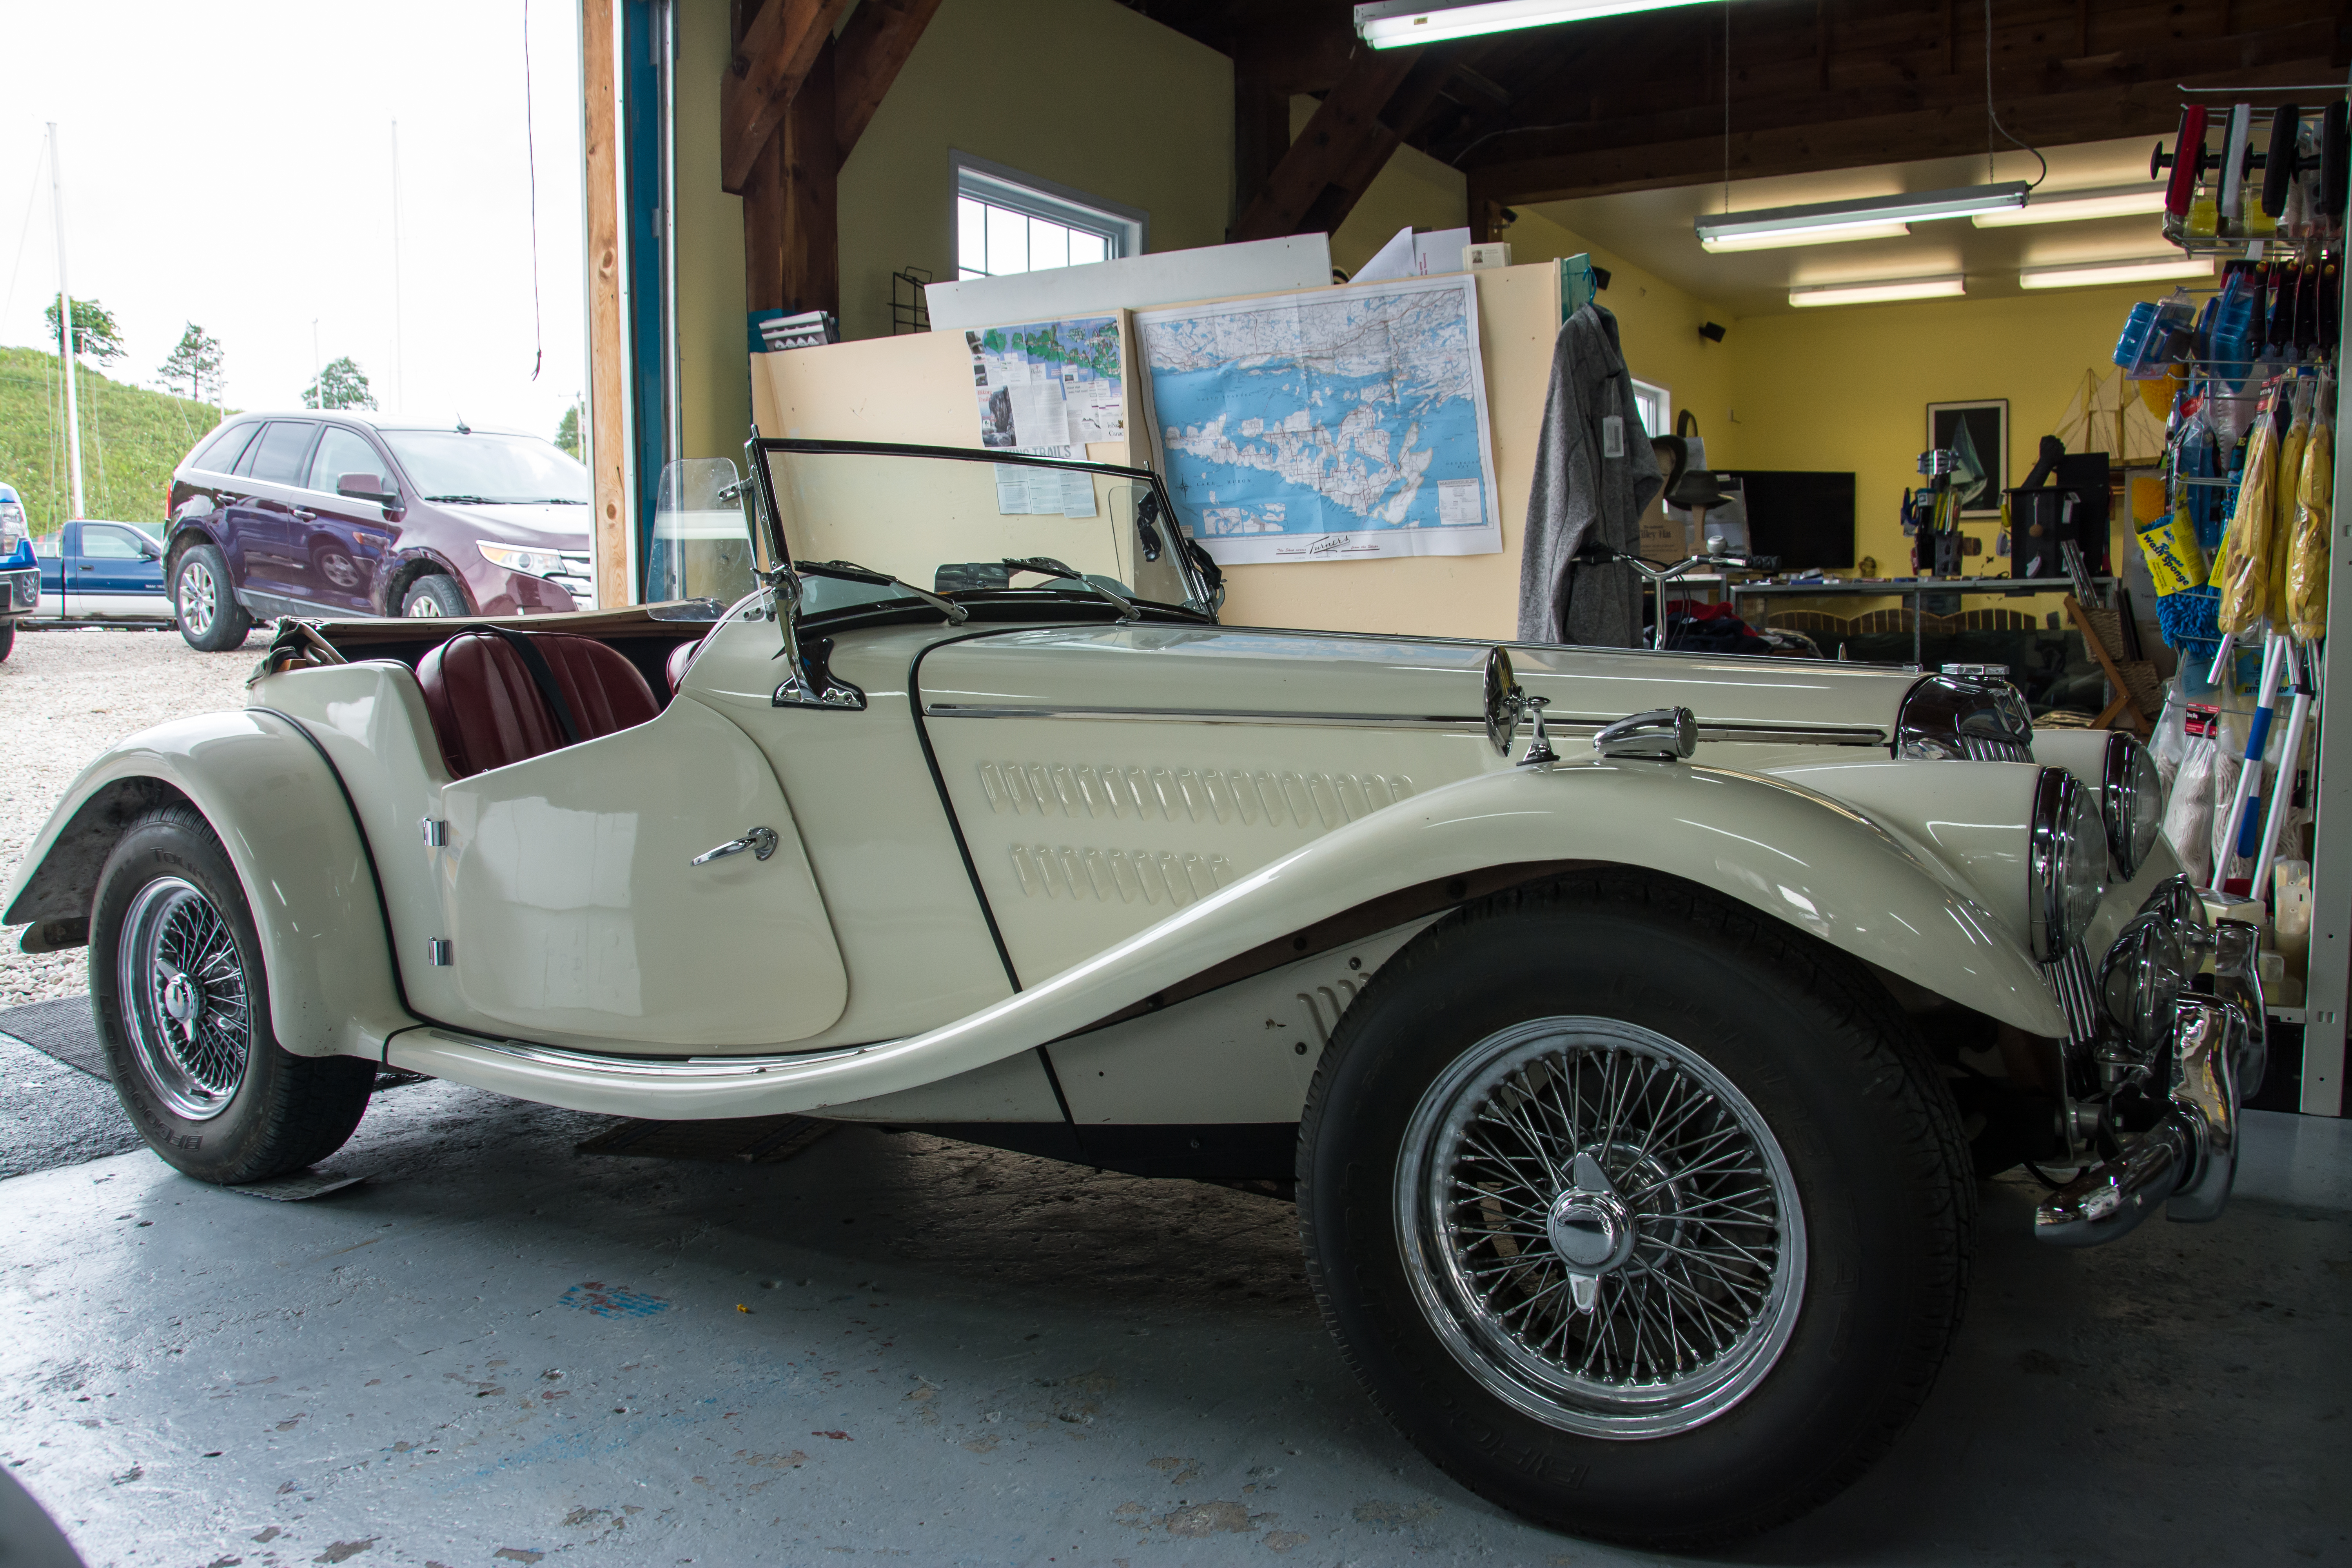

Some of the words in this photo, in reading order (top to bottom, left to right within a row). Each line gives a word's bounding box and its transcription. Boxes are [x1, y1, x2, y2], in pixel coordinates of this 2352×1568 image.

[1032, 446, 1071, 458] TRAILS
[1305, 535, 1350, 554] Turners
[2144, 534, 2166, 556] Wash
[2162, 555, 2189, 586] Sponge
[150, 848, 234, 928] Touring
[100, 996, 202, 1151] BFGoodrich
[1339, 1160, 1588, 1490] BFGoodrich
